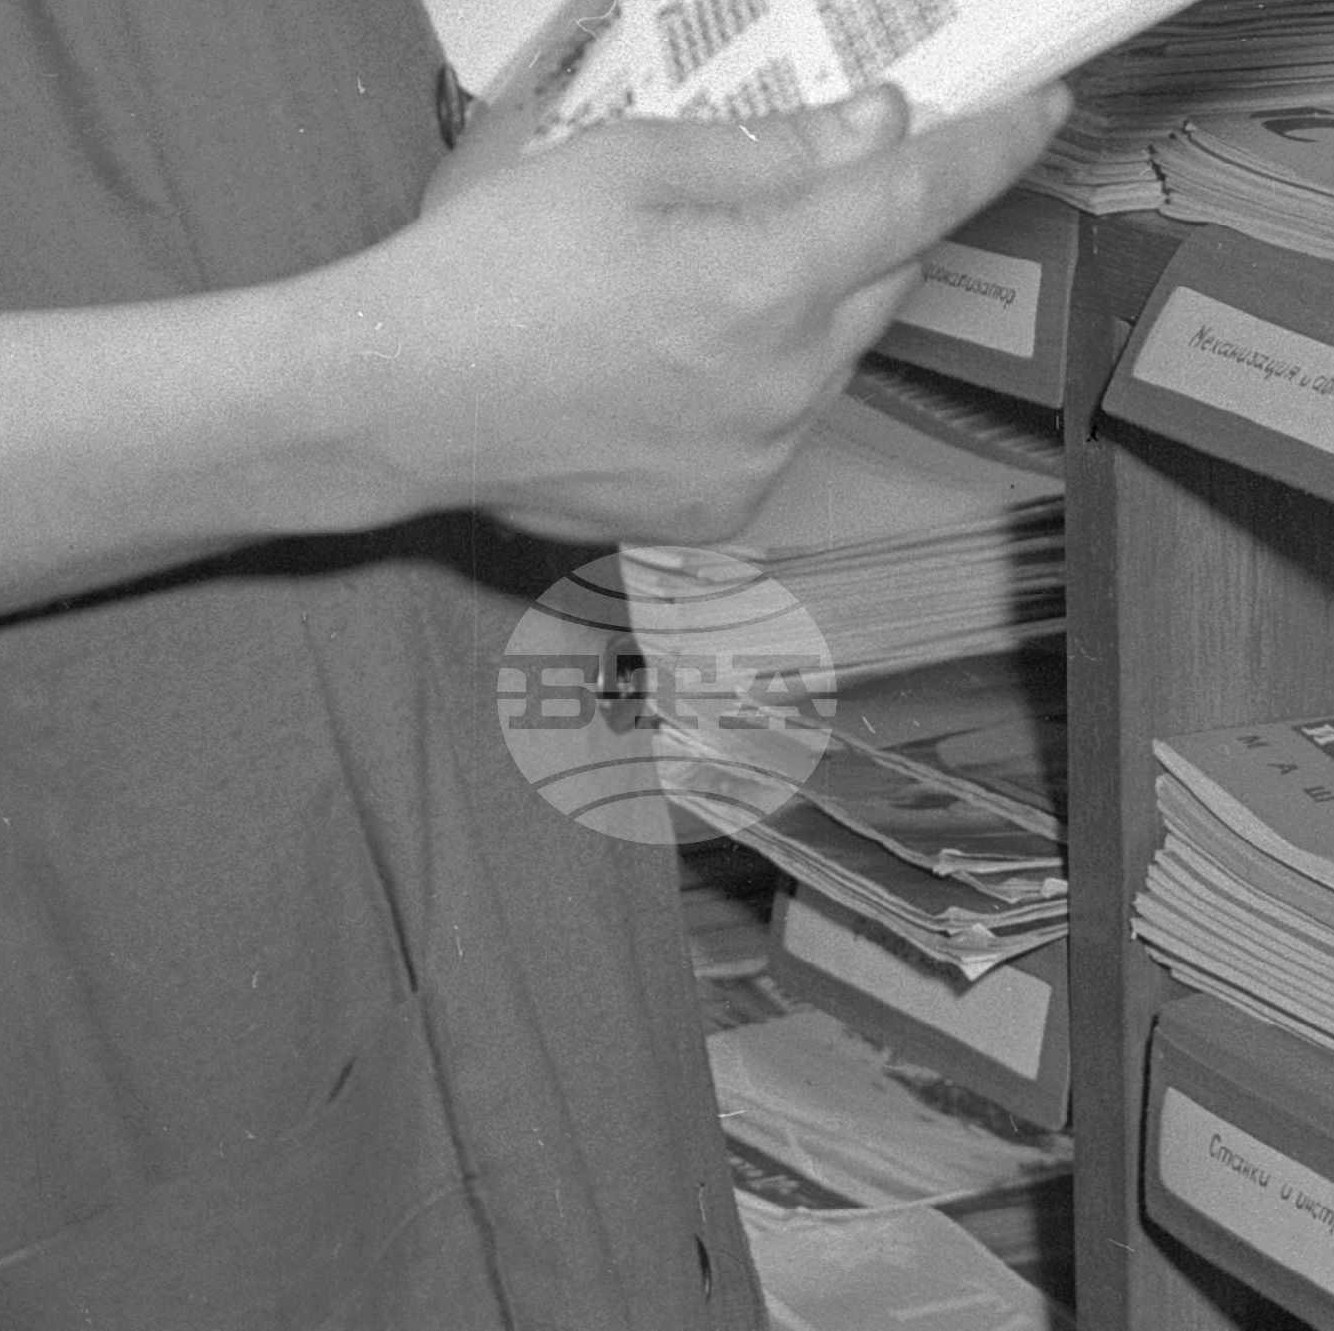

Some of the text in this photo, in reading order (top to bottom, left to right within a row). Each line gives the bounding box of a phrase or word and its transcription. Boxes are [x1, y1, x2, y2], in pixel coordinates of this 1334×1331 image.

[1189, 325, 1300, 382] Механизация
[1299, 373, 1312, 389] и
[1208, 1133, 1271, 1187] Станки
[1279, 1183, 1293, 1201] и
